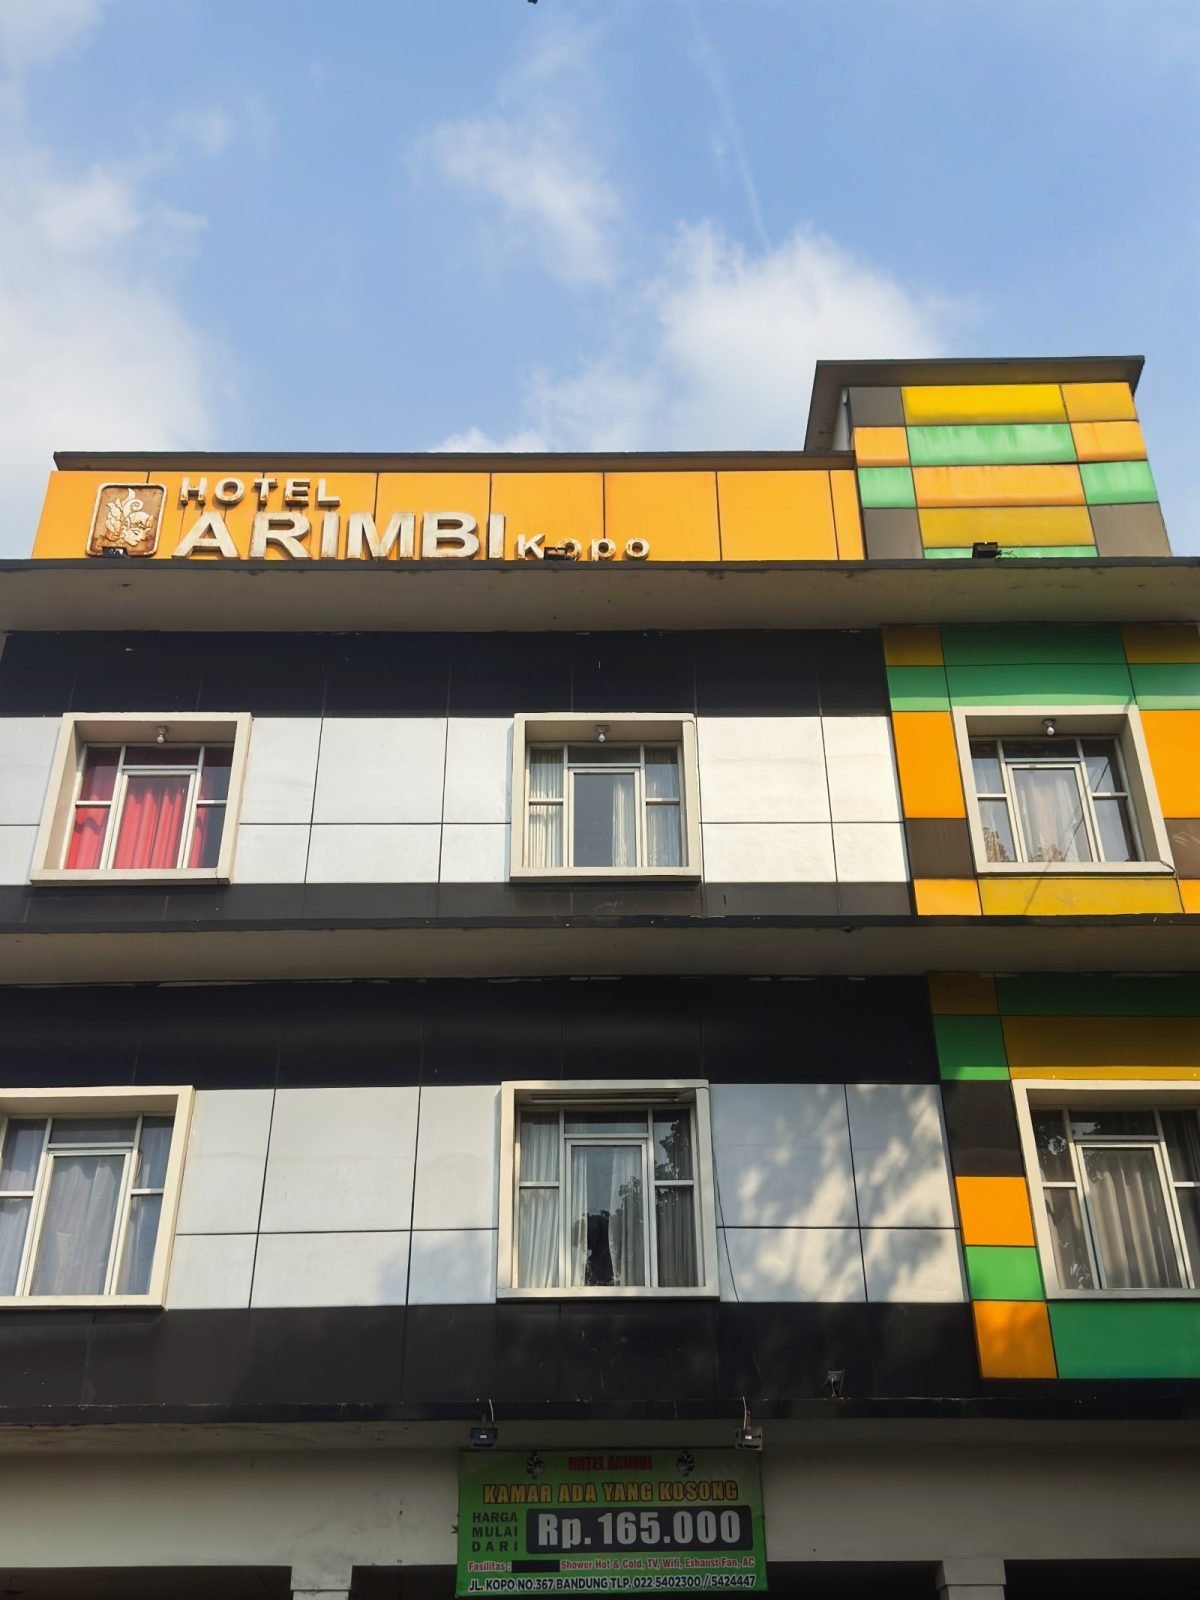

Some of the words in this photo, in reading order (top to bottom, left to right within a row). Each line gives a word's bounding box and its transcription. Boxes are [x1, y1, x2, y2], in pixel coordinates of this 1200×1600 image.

[180, 477, 340, 507] HOTEL
[171, 511, 506, 560] ARIMBI
[483, 1484, 552, 1504] KAMAR
[557, 1483, 597, 1503] ADA
[602, 1481, 653, 1502] YANG
[658, 1480, 739, 1501] KOSONG
[472, 1512, 518, 1523] HARGA
[472, 1526, 518, 1538] MULAI
[537, 1513, 592, 1549] Rp.
[598, 1510, 741, 1545] 165.000
[561, 1560, 593, 1570] Shower
[595, 1560, 610, 1570] Hot
[613, 1560, 620, 1569] &
[685, 1557, 720, 1567] Exhaust
[742, 1557, 755, 1566] AC
[469, 1579, 484, 1591] JL.
[486, 1579, 515, 1591] KOPO
[556, 1578, 608, 1590] BANDUNG
[610, 1577, 632, 1588] TLP.
[655, 1576, 701, 1587] 5402300
[711, 1575, 756, 1587] 5424447
